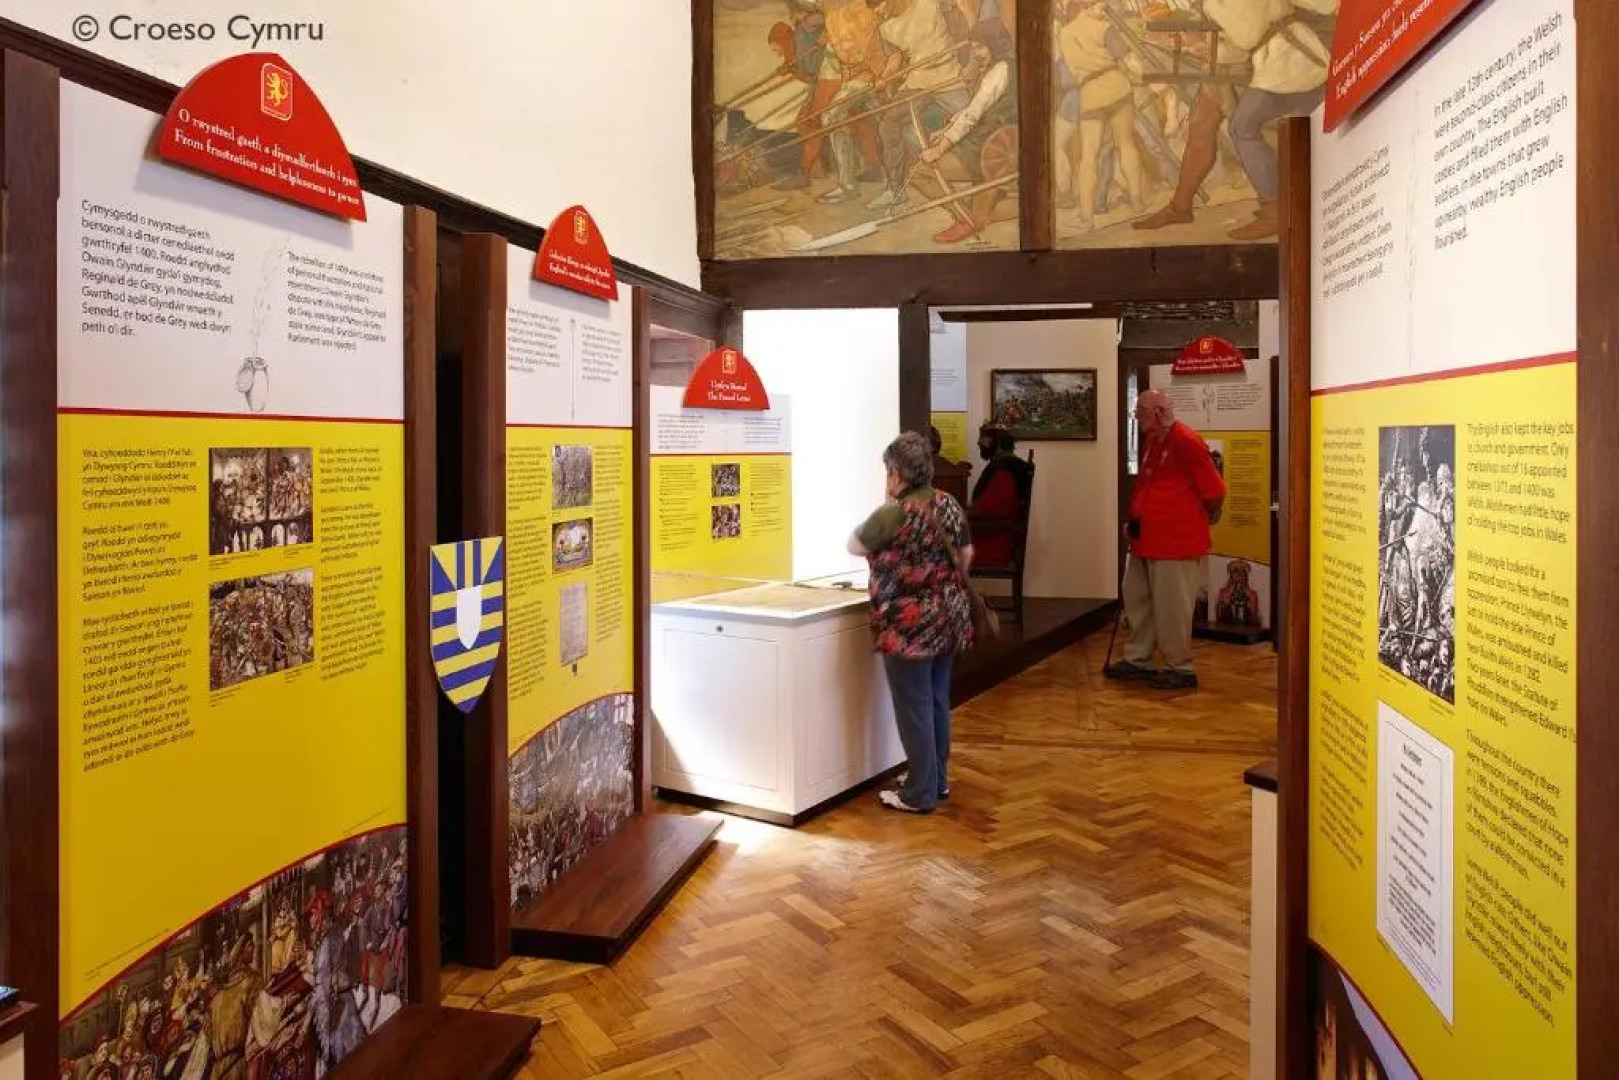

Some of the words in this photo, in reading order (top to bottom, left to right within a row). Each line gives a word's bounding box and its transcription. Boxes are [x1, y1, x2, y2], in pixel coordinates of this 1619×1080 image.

[1434, 105, 1440, 118] In
[1441, 97, 1451, 112] the
[1453, 86, 1465, 103] late
[1467, 71, 1483, 92] 13th
[1485, 51, 1516, 81] century,
[1518, 35, 1532, 56] the
[1534, 11, 1562, 43] Welsh
[1434, 121, 1449, 139] were
[1496, 67, 1526, 97] citizens
[1528, 59, 1536, 76] in
[1538, 42, 1560, 68] their
[1434, 145, 1448, 162] own
[1493, 95, 1521, 125] English
[1524, 80, 1544, 105] built
[1456, 151, 1468, 171] and
[1490, 130, 1510, 151] them
[1512, 114, 1531, 137] with
[1534, 93, 1568, 126] English
[174, 128, 204, 151] From
[207, 139, 258, 170] frustration
[260, 160, 276, 176] and
[278, 164, 326, 194] helplessness
[328, 187, 336, 197] to
[1469, 171, 1481, 187] the
[1482, 158, 1505, 180] towns
[1507, 147, 1524, 167] that
[1526, 135, 1550, 161] grew
[1469, 188, 1498, 210] wealthy
[1500, 169, 1529, 197] English
[1531, 153, 1564, 185] people
[82, 199, 138, 223] Cymysgedd
[140, 216, 146, 225] o
[82, 217, 124, 236] bersonol
[127, 229, 132, 238] a
[82, 236, 131, 254] gwrthryfel
[160, 251, 186, 265] Roedd
[82, 251, 114, 267] Owain
[82, 268, 125, 285] Reginald
[126, 276, 138, 288] de
[164, 285, 175, 295] yn
[82, 285, 125, 303] Gwrthod
[82, 321, 105, 333] peth
[135, 310, 152, 323] bod
[154, 314, 166, 324] de
[168, 314, 186, 329] Grey
[1530, 422, 1542, 434] the
[1543, 424, 1555, 436] key
[1556, 423, 1573, 436] jobs
[1494, 443, 1505, 454] and
[1550, 442, 1568, 460] Only
[1508, 482, 1521, 494] and
[1541, 488, 1554, 498] was
[1550, 507, 1570, 523] hope
[1536, 526, 1543, 538] in
[1484, 556, 1505, 570] people
[1541, 571, 1545, 581] a
[1524, 624, 1546, 644] Prince
[1548, 633, 1556, 646] of
[1555, 616, 1567, 630] the
[1533, 650, 1546, 665] and
[1548, 653, 1568, 674] killed
[1502, 753, 1512, 767] the
[1513, 760, 1538, 787] country
[1540, 776, 1559, 798] there
[1548, 822, 1568, 848] Hope
[1538, 922, 1552, 939] well
[1548, 947, 1572, 980] Owain
